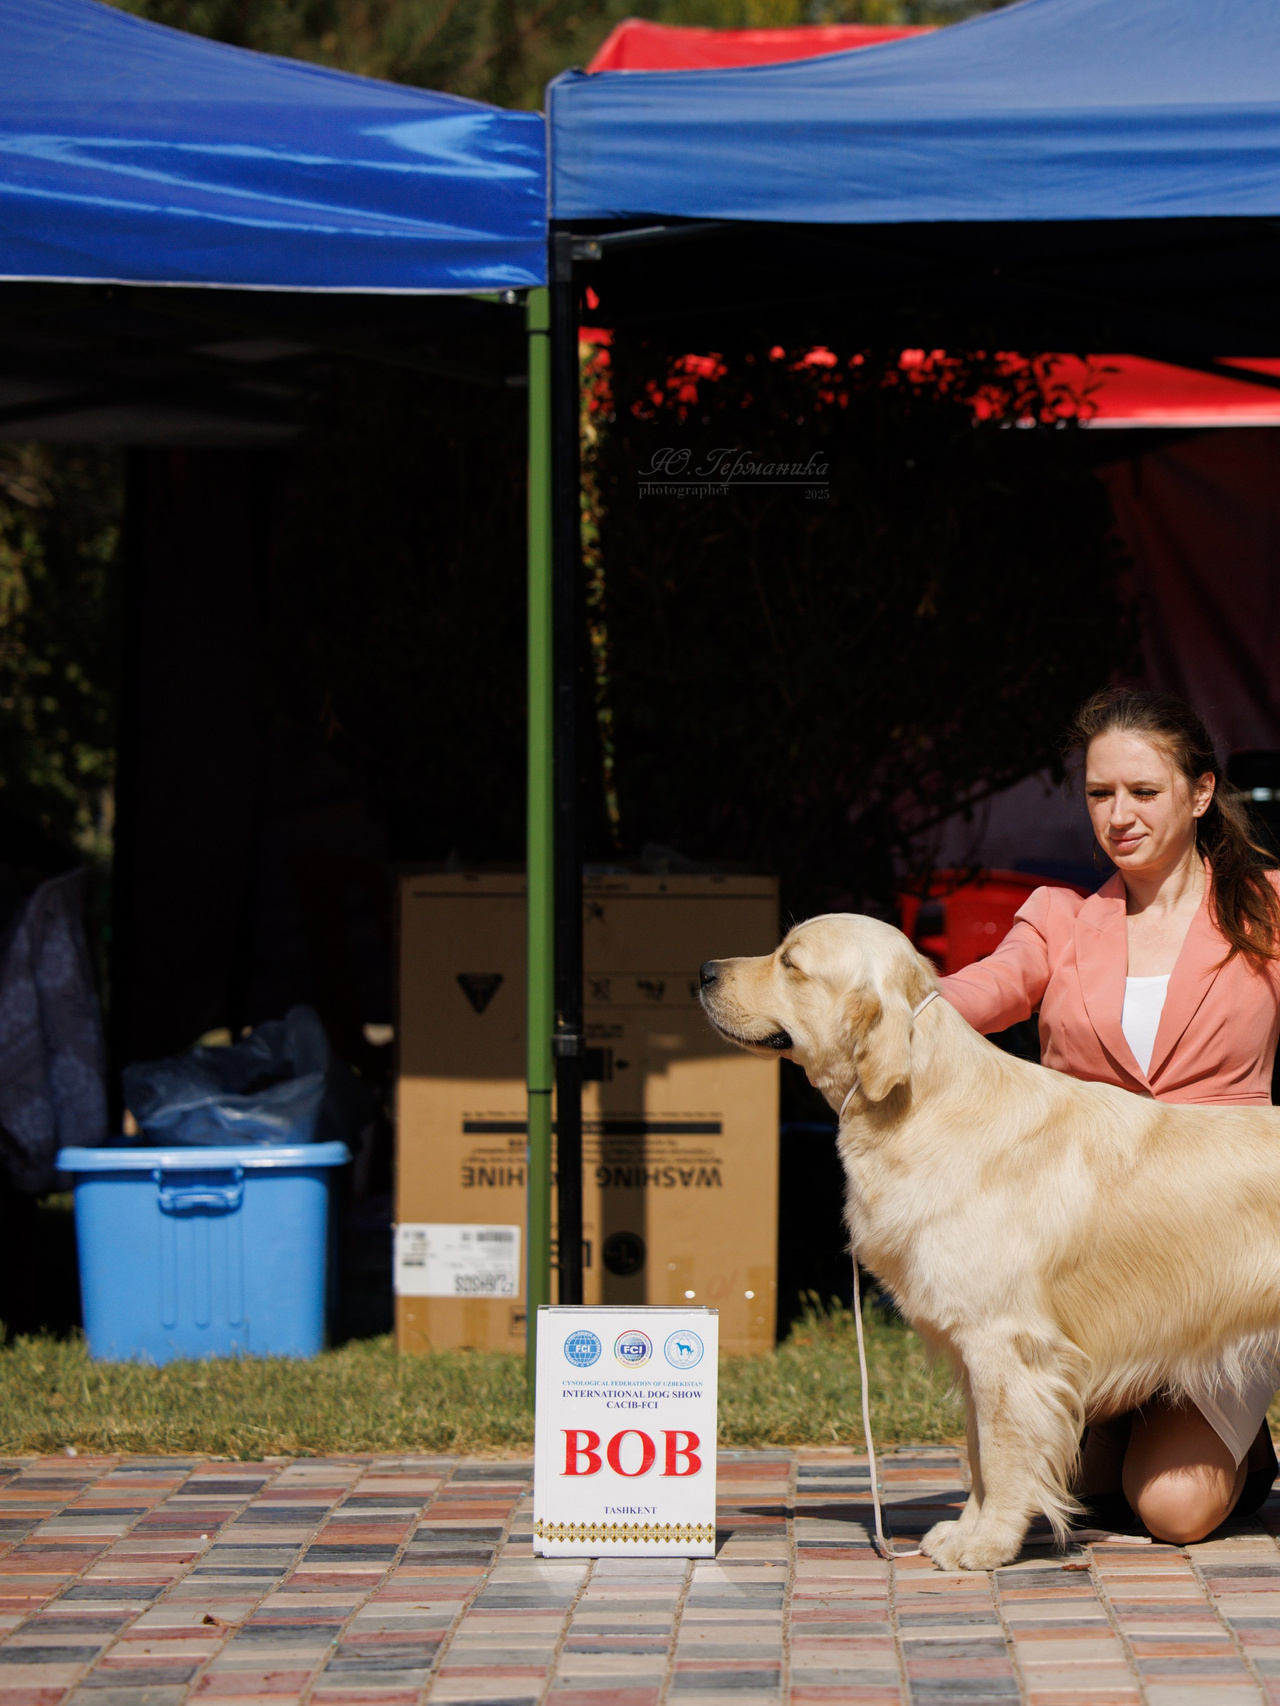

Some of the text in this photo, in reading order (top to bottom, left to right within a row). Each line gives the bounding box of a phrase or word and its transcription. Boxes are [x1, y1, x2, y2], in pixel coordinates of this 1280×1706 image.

[595, 1165, 723, 1188] WASHING
[576, 1345, 591, 1353] FCI
[623, 1346, 643, 1354] FCI
[562, 1390, 703, 1399] INTERNATIONAL DOG SHOW
[606, 1401, 659, 1409] CACIB-FCI
[559, 1429, 702, 1478] BOB
[603, 1506, 658, 1515] TASHKENT
